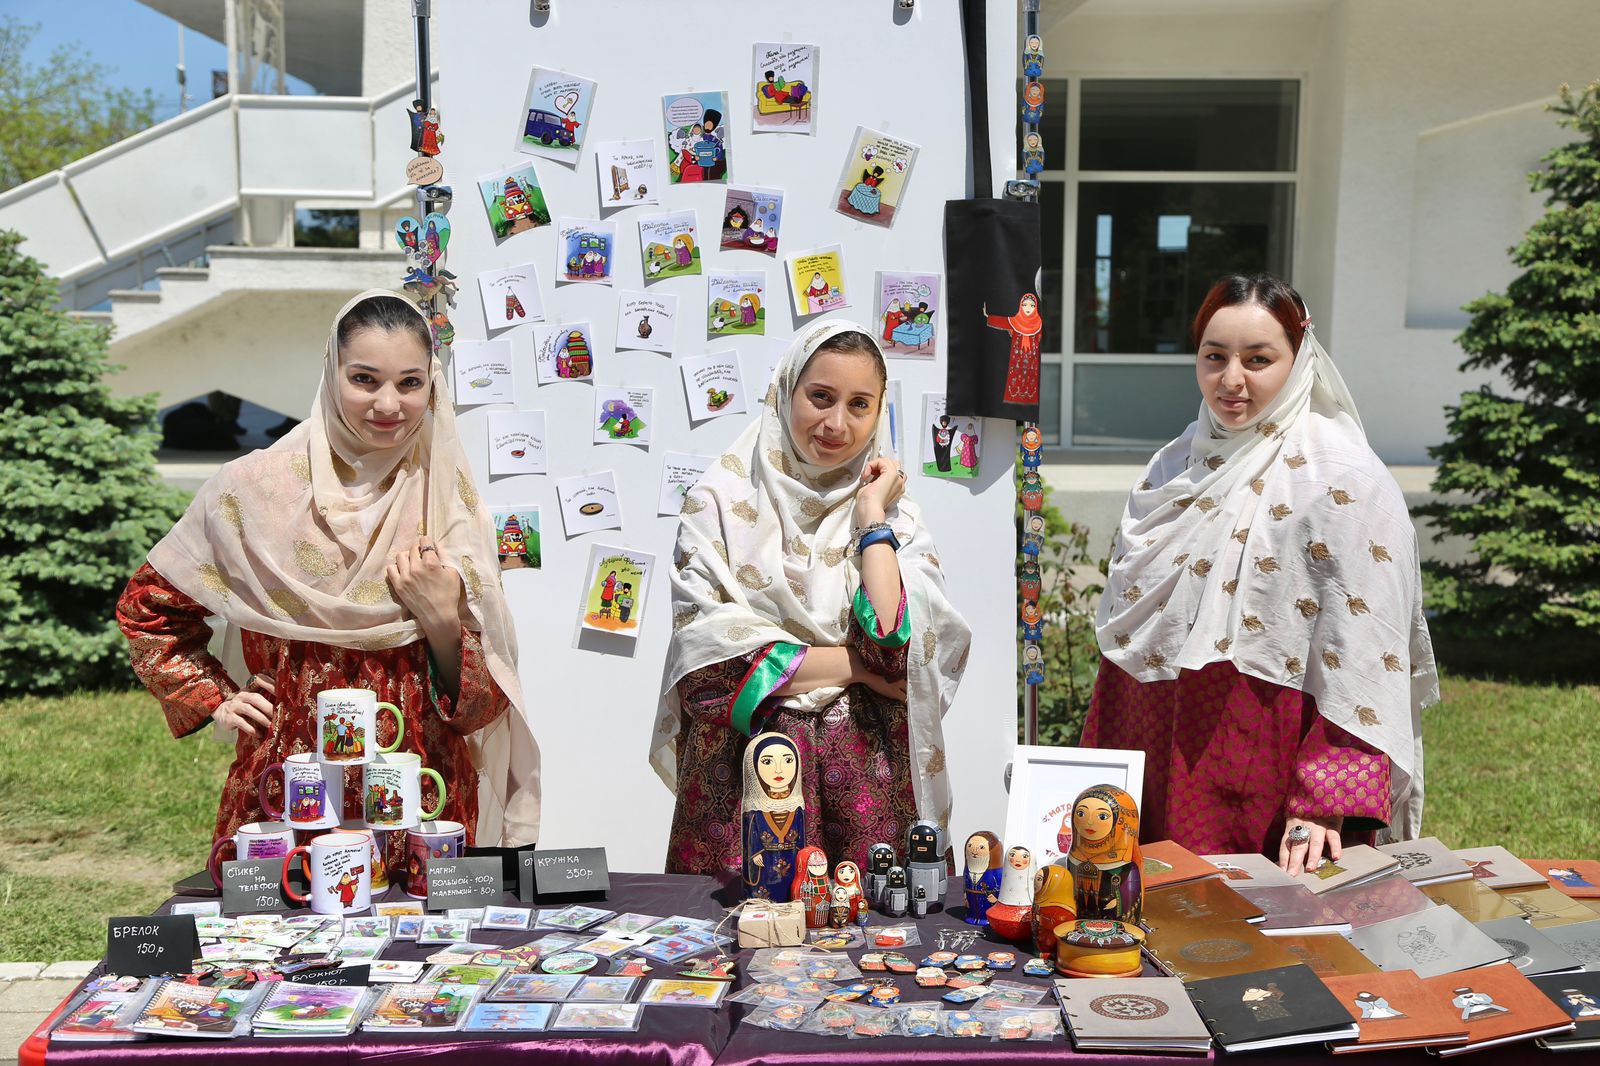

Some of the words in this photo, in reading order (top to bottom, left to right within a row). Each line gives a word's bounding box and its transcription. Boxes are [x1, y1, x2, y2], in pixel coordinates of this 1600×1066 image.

[1048, 803, 1072, 818] матр
[538, 855, 580, 867] КРУЖКА
[227, 866, 260, 878] СТИКЕР
[429, 866, 456, 875] МАГНИТ
[566, 868, 593, 880] 350р
[238, 882, 279, 892] ТЕЛЕФОН
[432, 875, 469, 887] БОЛЬШОЙ
[432, 886, 472, 897] МАЛЕНЬКИЙ
[255, 896, 280, 908] 150р
[113, 925, 160, 939] БРЕЛОК
[291, 968, 346, 982] БЛОКНОТ
